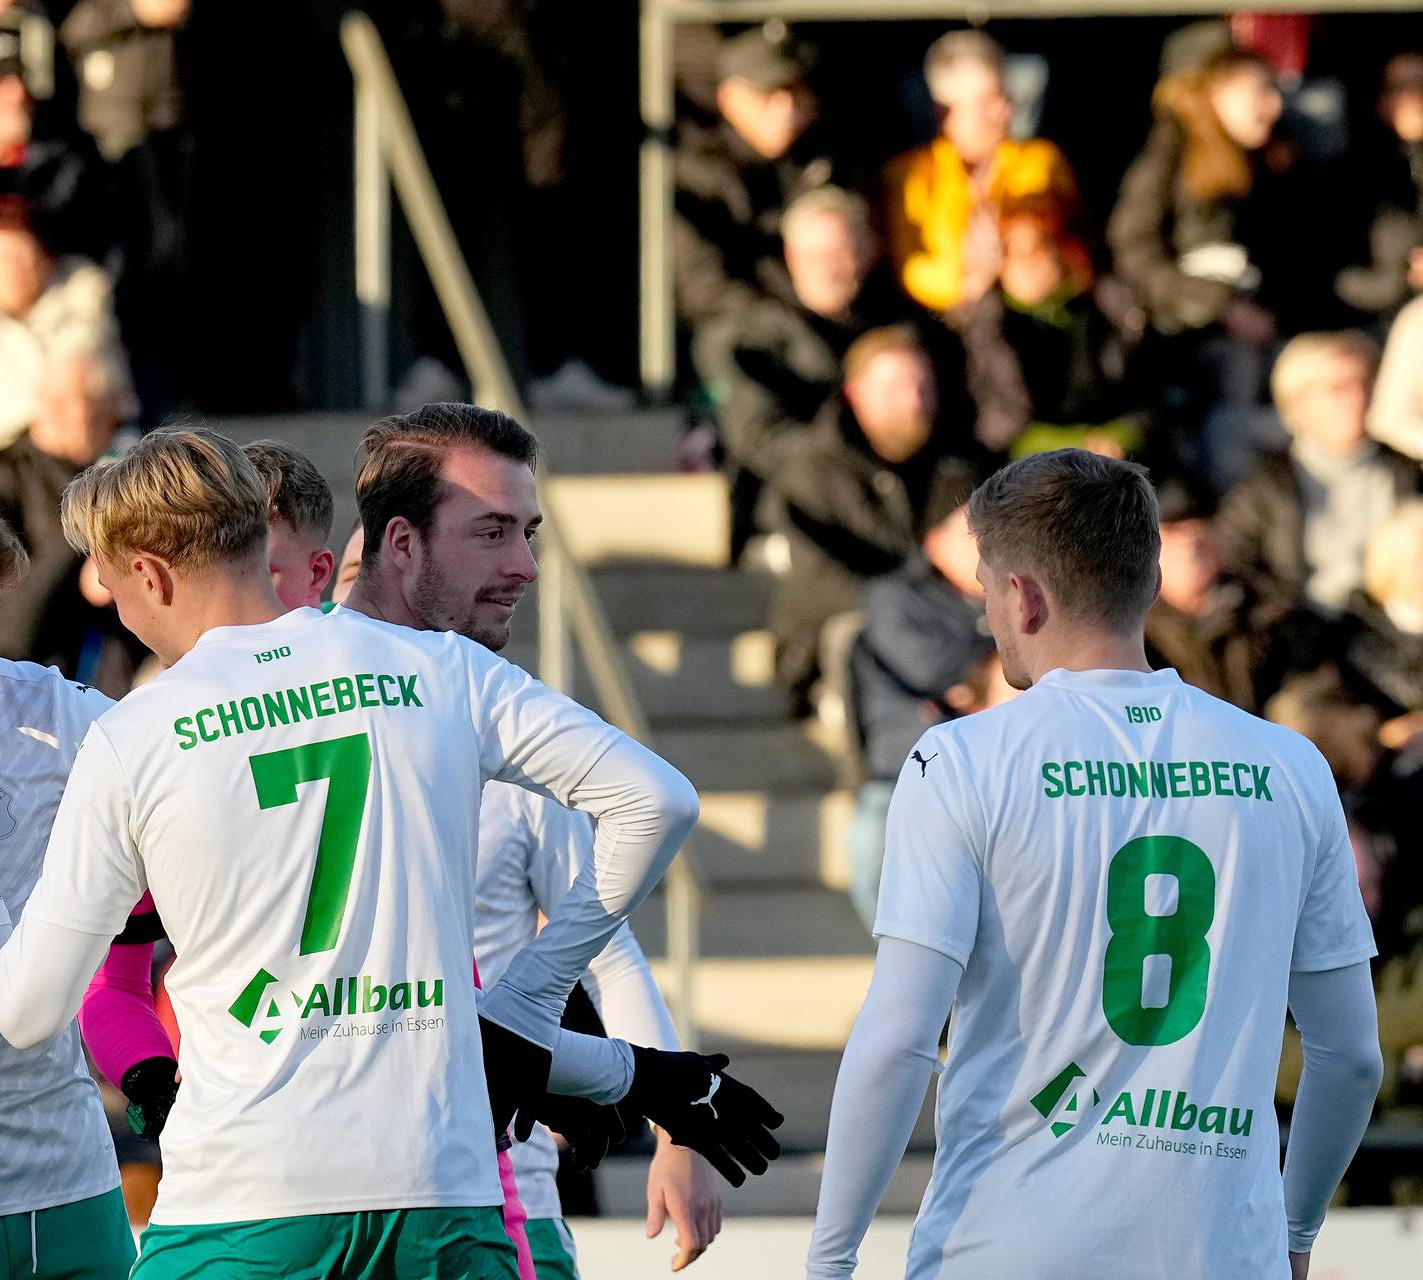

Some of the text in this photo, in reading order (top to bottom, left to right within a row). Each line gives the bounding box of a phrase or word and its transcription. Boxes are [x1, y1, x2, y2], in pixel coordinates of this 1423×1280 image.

[253, 645, 292, 664] 1910
[173, 673, 424, 751] SCHONNEBECK
[1125, 705, 1162, 724] 1910
[1041, 760, 1274, 802] SCHONNEBECK
[248, 732, 373, 957] 7
[1101, 834, 1216, 1047] 8
[300, 975, 444, 1019] Allbau
[300, 1017, 444, 1041] Mein Zuhause in Essen
[1100, 1087, 1254, 1137] Allbau
[1096, 1132, 1247, 1160] Mein Zuhause in Essen
